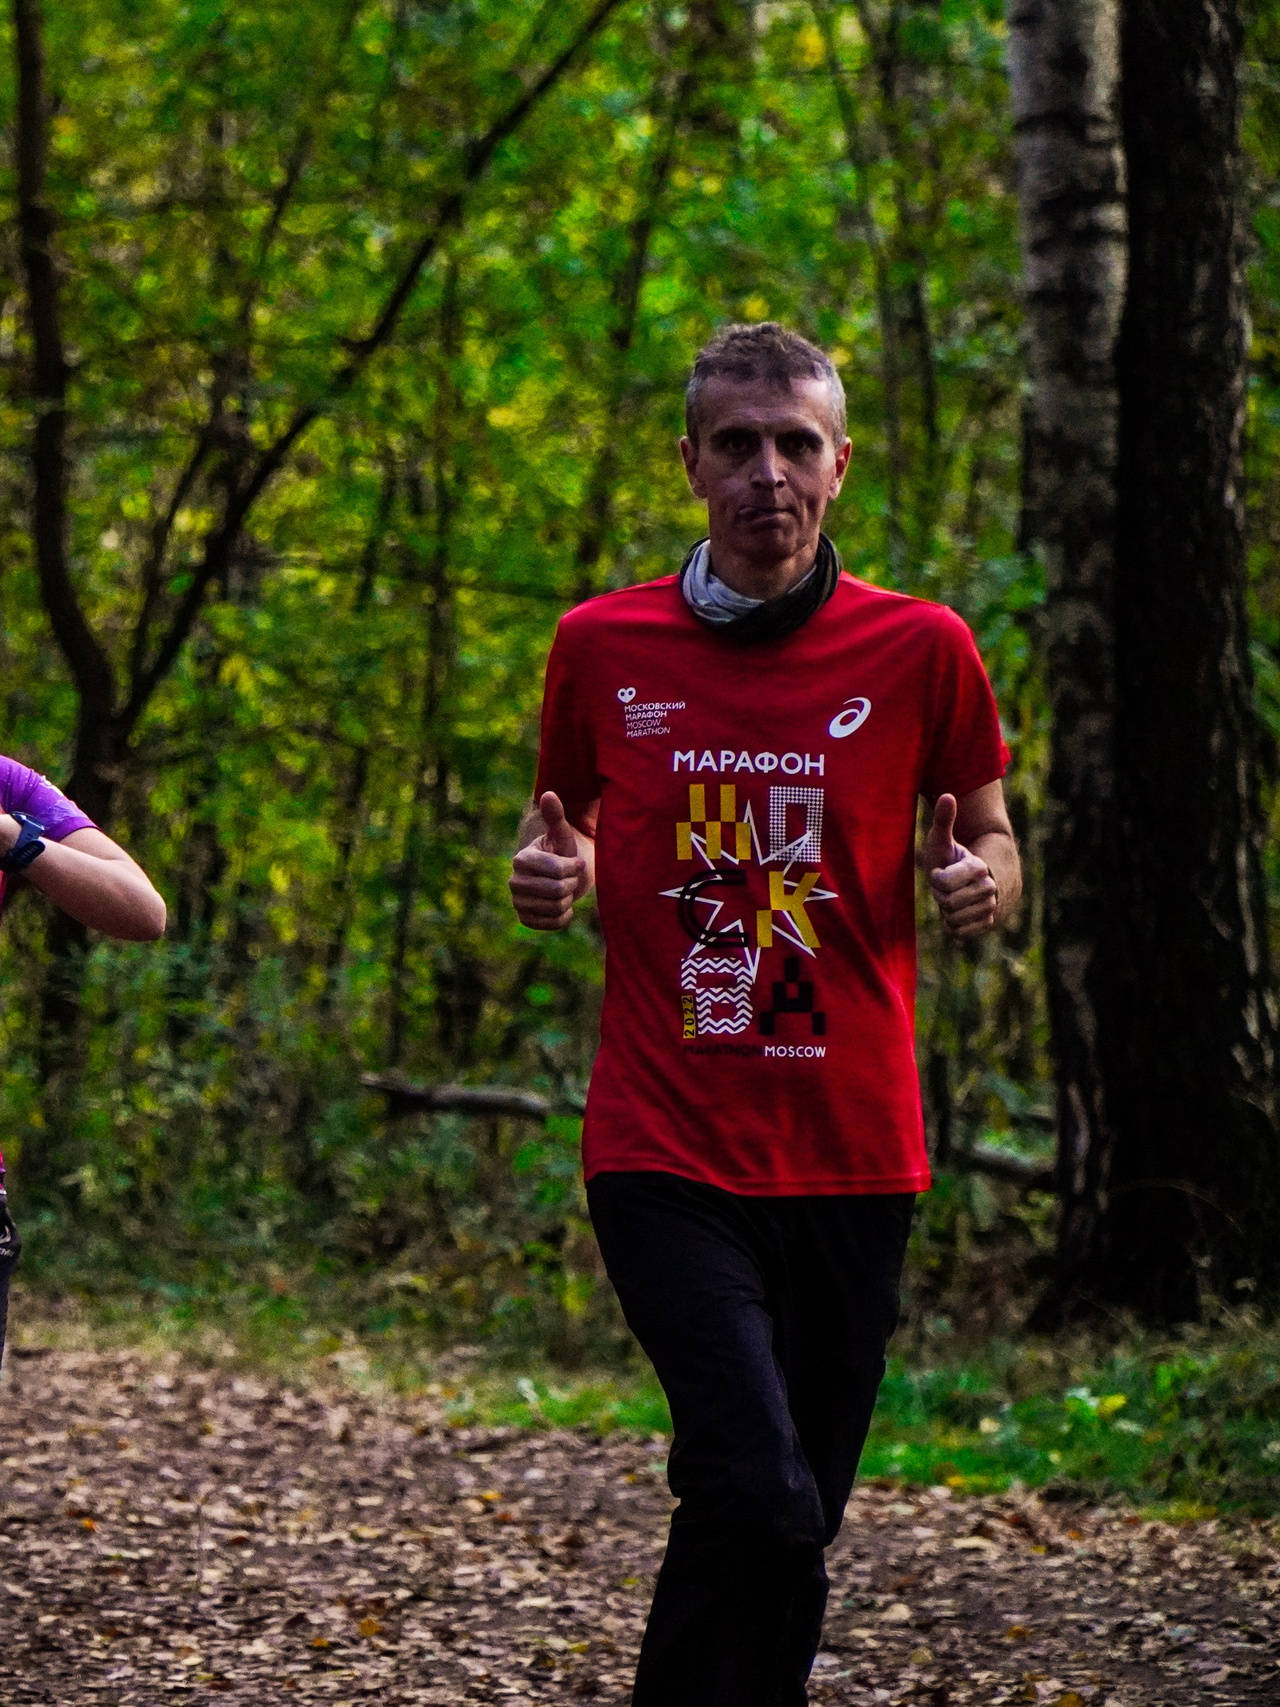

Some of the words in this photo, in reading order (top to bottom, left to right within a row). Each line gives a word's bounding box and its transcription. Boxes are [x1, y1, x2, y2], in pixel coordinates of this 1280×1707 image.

[624, 701, 686, 713] МОСКОВСКИЙ
[625, 710, 668, 721] МАРАФОН
[626, 719, 662, 730] MOSCOW
[626, 727, 671, 738] MARATHON
[673, 750, 825, 776] МАРАФОН
[682, 997, 695, 1037] 2022
[764, 1046, 826, 1058] MOSCOW
